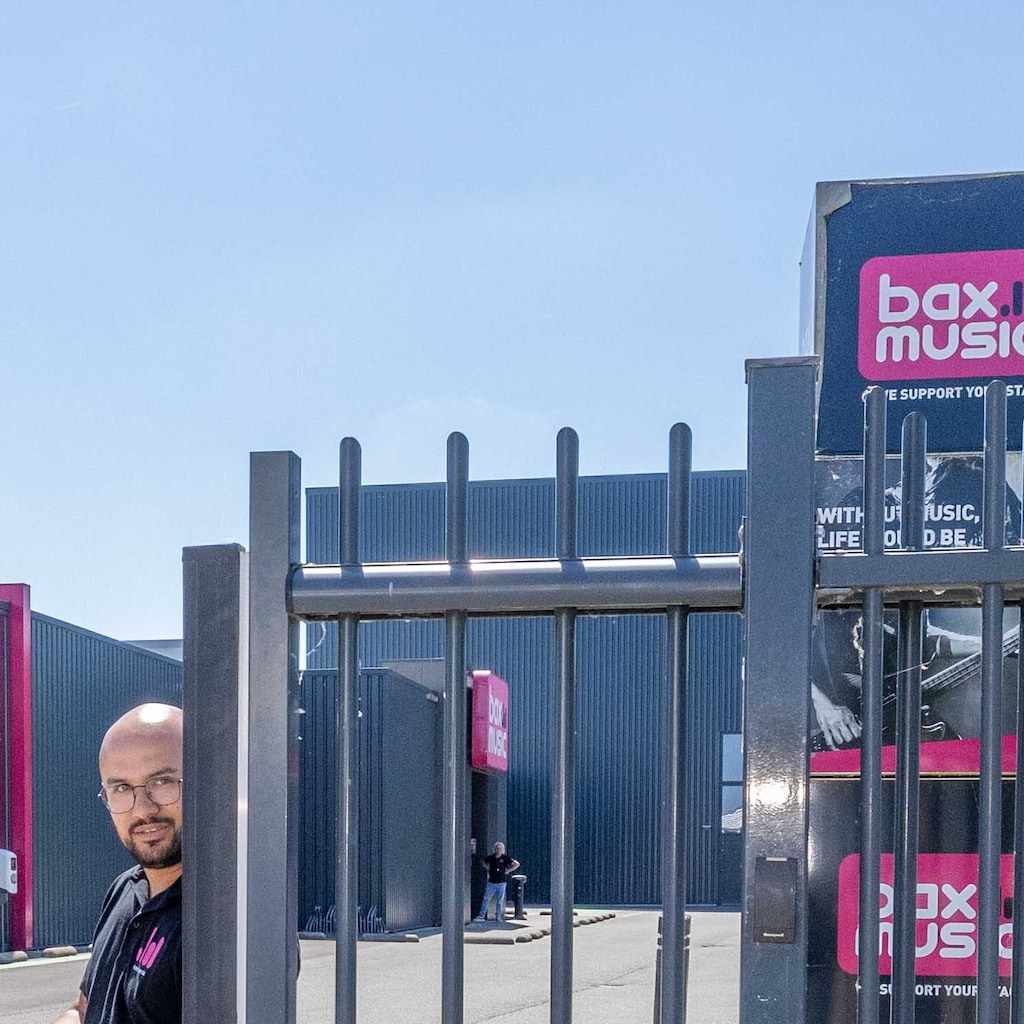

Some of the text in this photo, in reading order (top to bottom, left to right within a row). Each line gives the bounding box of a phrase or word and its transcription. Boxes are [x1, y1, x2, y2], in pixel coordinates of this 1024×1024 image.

[900, 387, 963, 400] SUPPORT
[817, 530, 860, 547] LIFE
[940, 529, 967, 546] BE
